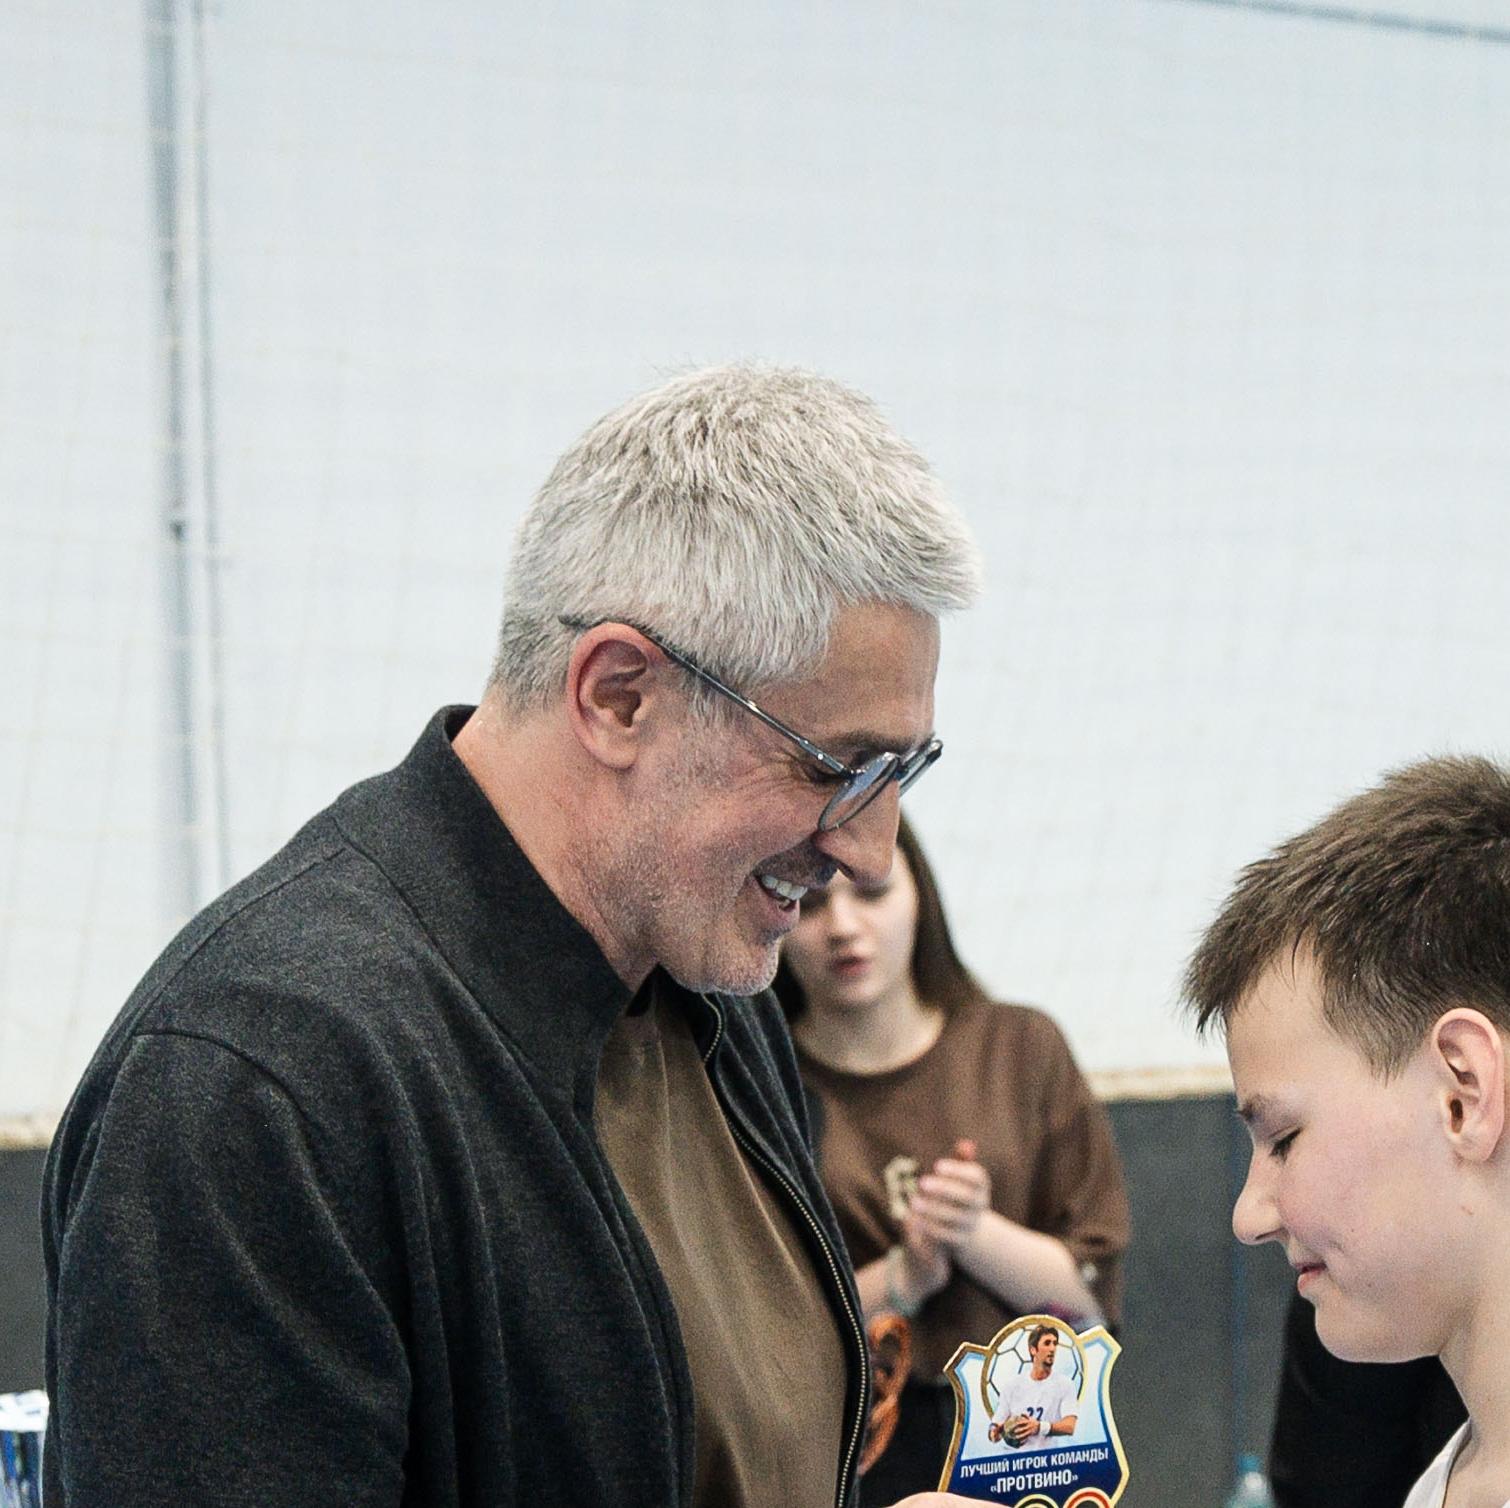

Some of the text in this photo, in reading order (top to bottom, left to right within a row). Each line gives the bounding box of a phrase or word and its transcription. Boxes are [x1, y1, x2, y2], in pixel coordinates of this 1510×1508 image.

[960, 1447, 1109, 1479] ЛУЧШИЙ ИГРОК КОМАНДЫ
[990, 1469, 1079, 1494] «ПРОТВИНО»
